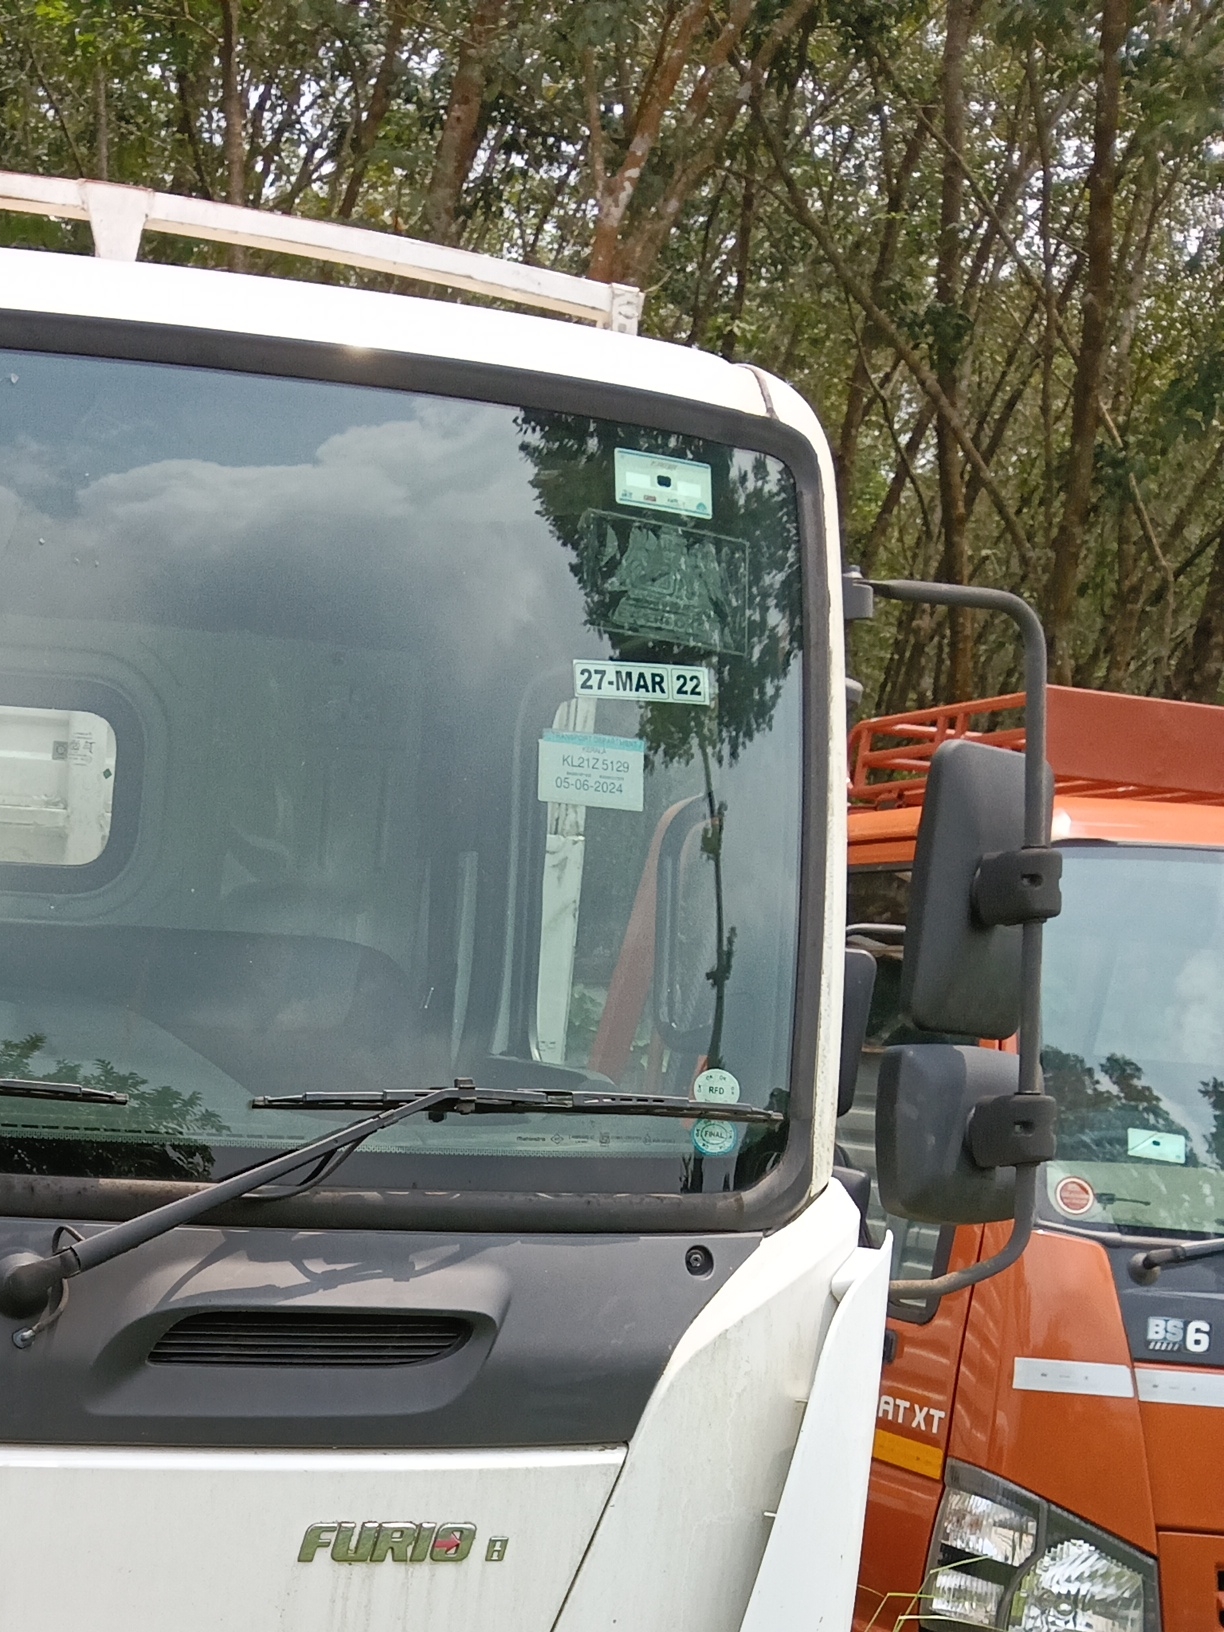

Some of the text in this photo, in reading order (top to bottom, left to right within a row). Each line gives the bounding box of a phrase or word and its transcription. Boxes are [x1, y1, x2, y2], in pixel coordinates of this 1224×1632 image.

[579, 668, 702, 696] 27-MAR 22
[555, 776, 623, 794] 05-06-2024
[705, 1130, 725, 1138] FINAL
[297, 1520, 477, 1563] FURIO
